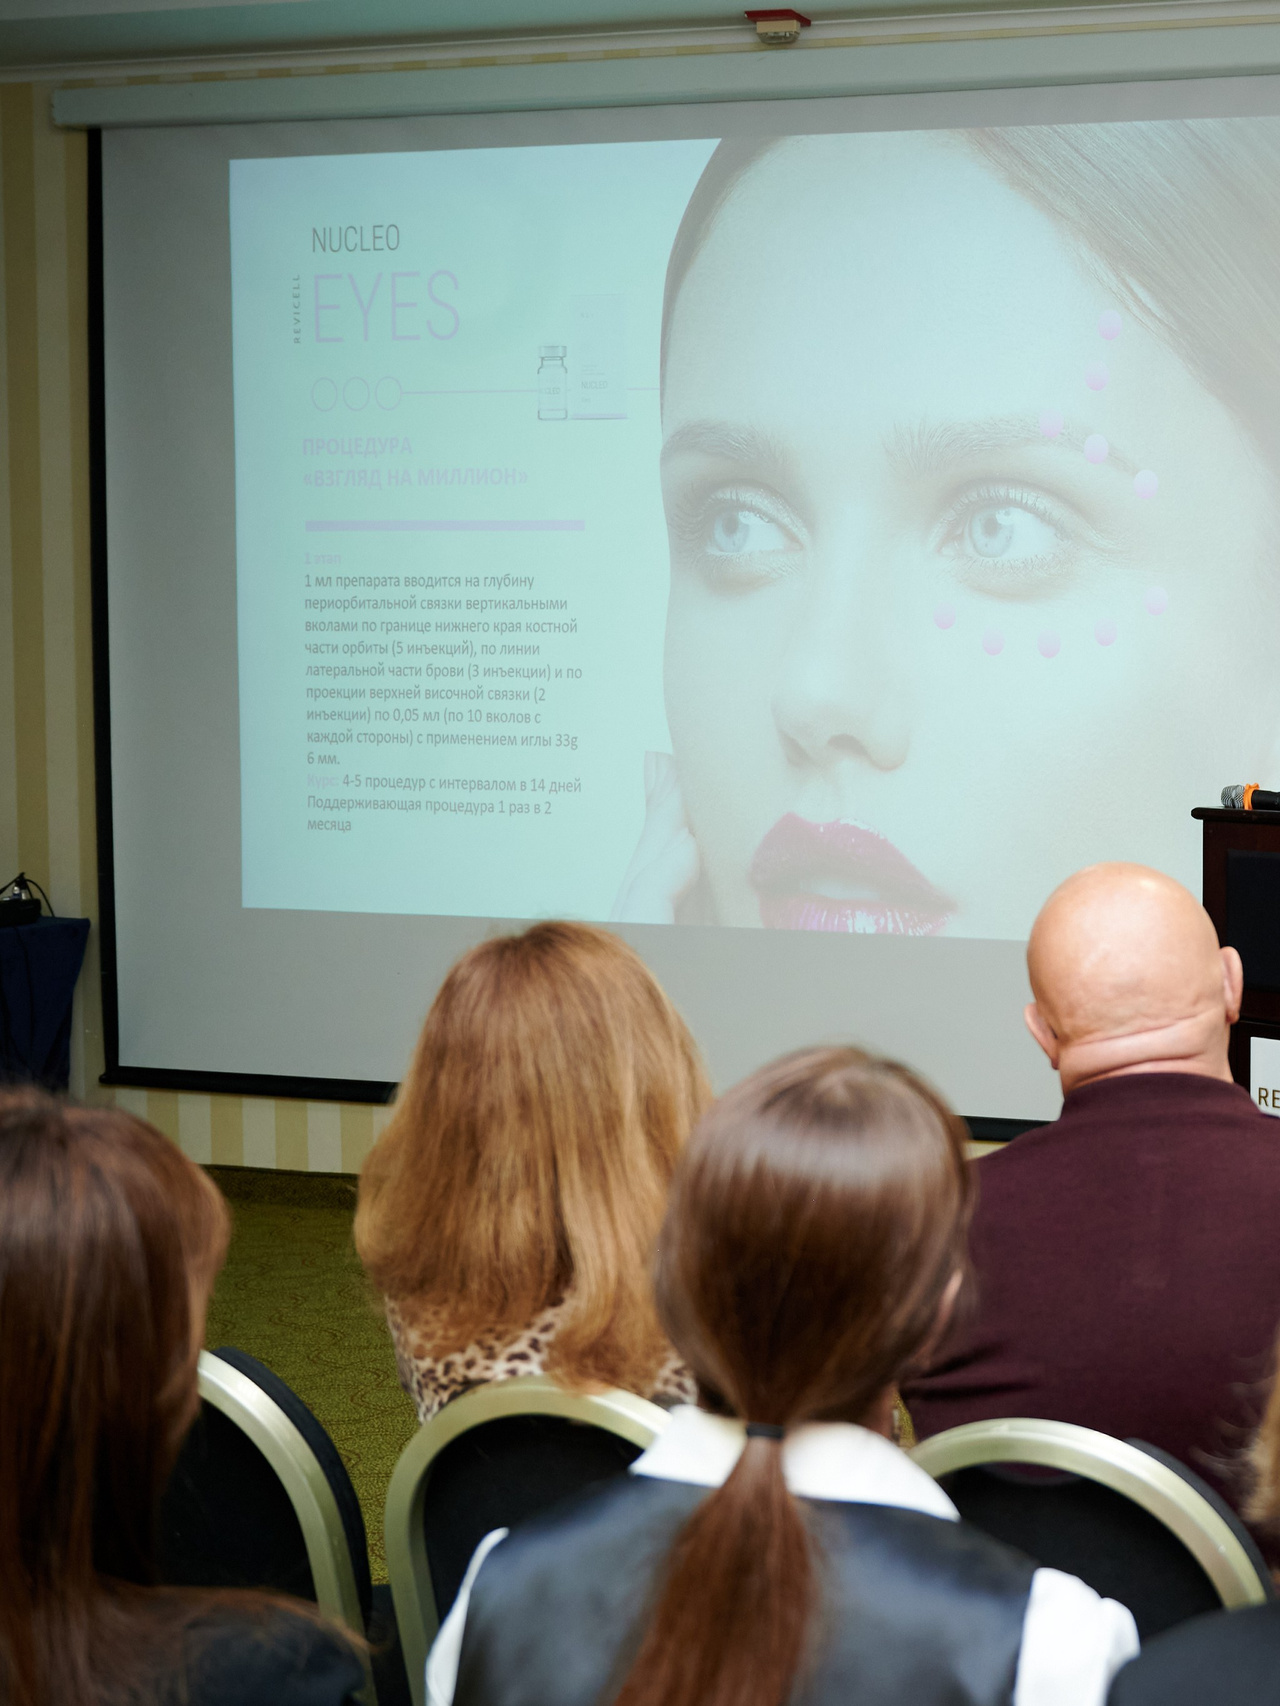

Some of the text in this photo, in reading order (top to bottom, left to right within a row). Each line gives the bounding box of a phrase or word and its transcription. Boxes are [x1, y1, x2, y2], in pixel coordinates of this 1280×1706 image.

[311, 224, 400, 253] NUCLEO
[314, 270, 460, 344] EYES
[302, 437, 413, 458] ПРОЦЕДУРА
[387, 468, 412, 486] НА
[335, 573, 534, 590] препарата вводится глубину
[304, 595, 568, 613] периорбитальной связки вертикальными
[305, 618, 578, 636] вколами границе нижнего края костной
[305, 643, 338, 655] части
[342, 640, 388, 657] орбиты
[499, 644, 540, 656] линии
[305, 662, 385, 677] латеральной
[388, 664, 422, 677] части
[426, 663, 464, 680] брови
[305, 684, 530, 702] проекции верхней височной связки
[486, 711, 531, 724] вколов
[306, 729, 353, 745] каждой
[426, 733, 517, 747] применением
[520, 735, 552, 748] иглы
[555, 733, 578, 750] 33g
[342, 774, 581, 795] 4-5 процедур интервалом дней
[307, 795, 495, 815] Поддерживающая процедура
[307, 819, 352, 832] месяца
